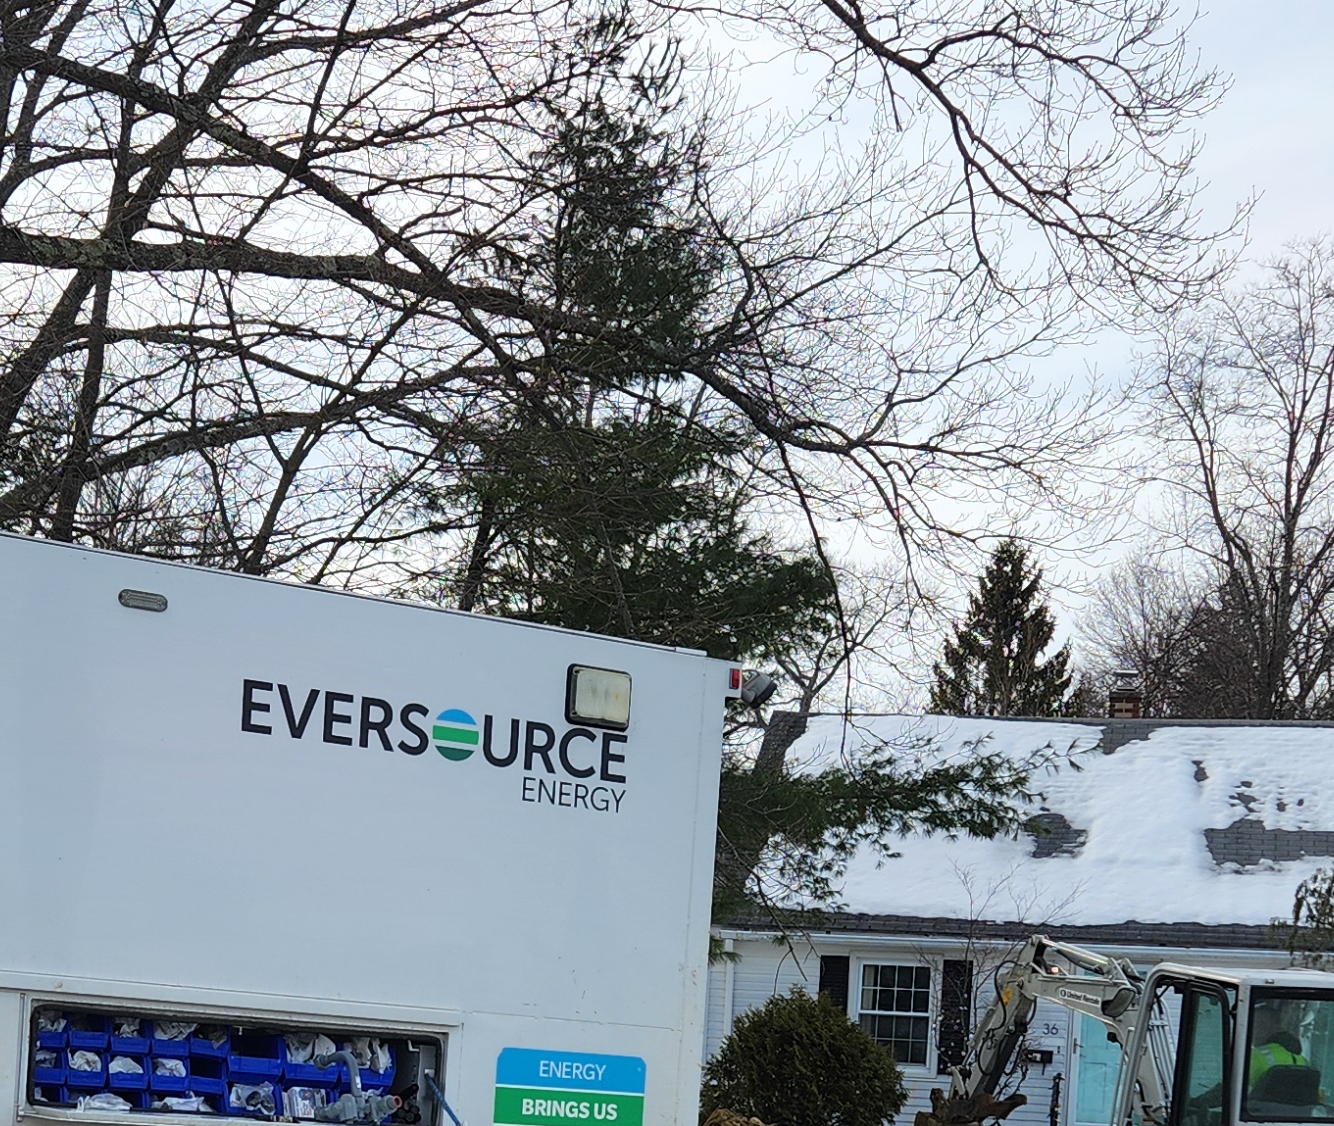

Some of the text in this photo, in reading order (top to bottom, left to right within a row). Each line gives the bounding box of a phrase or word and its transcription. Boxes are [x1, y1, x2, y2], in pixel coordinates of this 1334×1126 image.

[241, 678, 629, 784] EVERSOURCE
[521, 776, 627, 813] ENERGY
[1042, 1022, 1059, 1036] 36
[539, 1059, 607, 1081] ENERGY
[521, 1098, 618, 1121] BRINGS US
